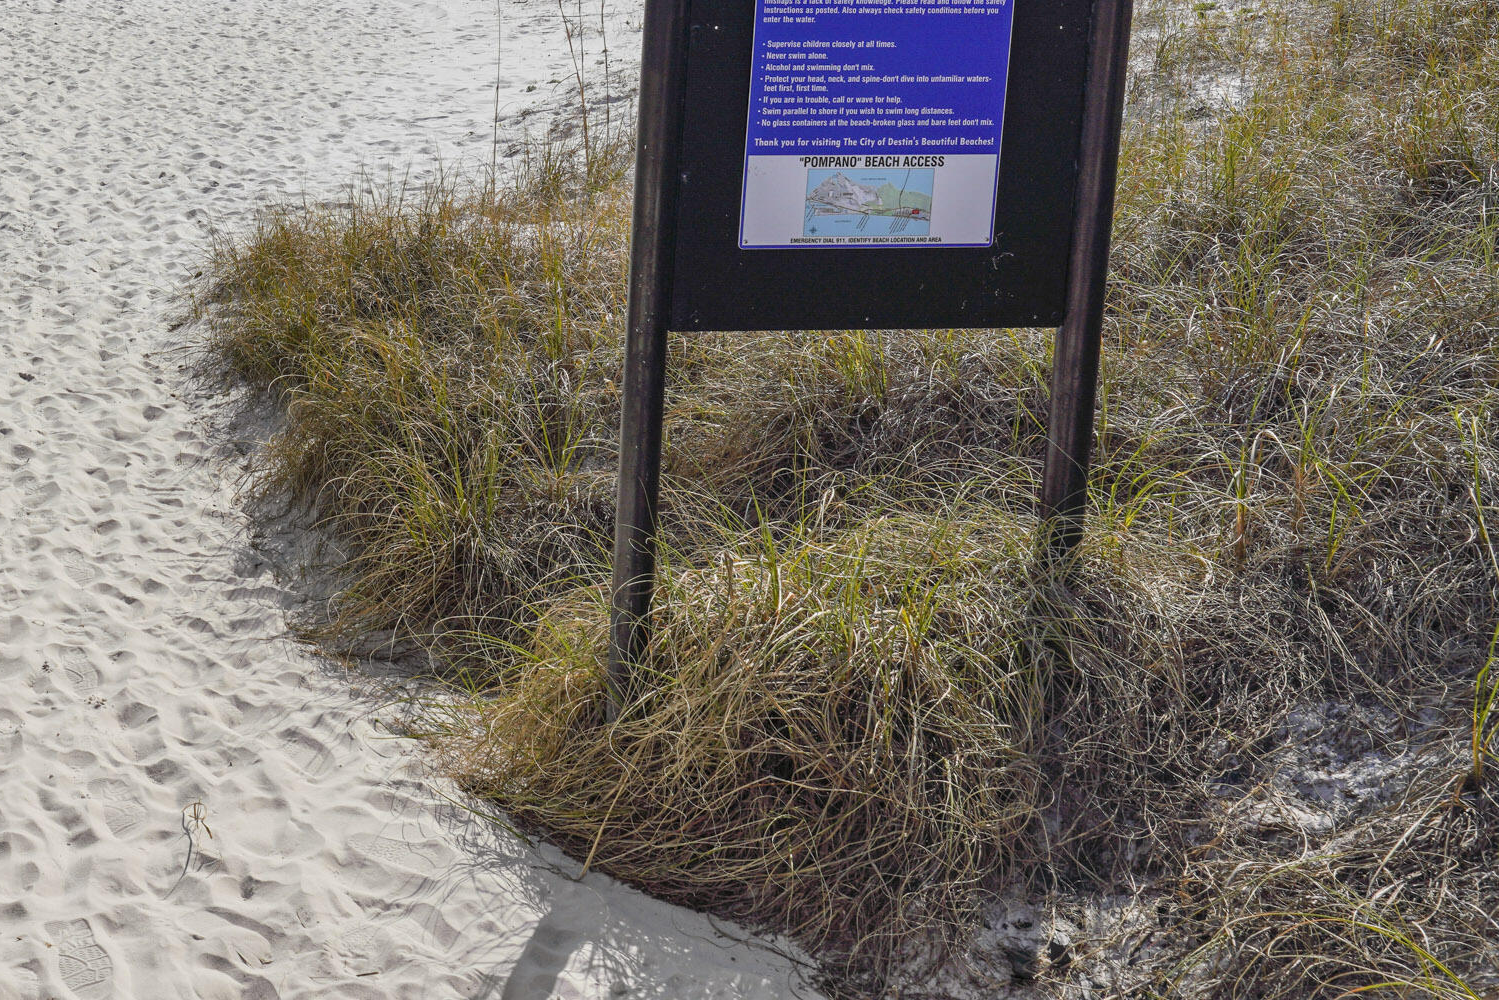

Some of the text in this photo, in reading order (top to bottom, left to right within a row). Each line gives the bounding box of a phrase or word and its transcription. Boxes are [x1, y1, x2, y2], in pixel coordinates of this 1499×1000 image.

[858, 7, 882, 15] always
[905, 7, 926, 15] safety
[767, 40, 801, 49] Supervise
[832, 40, 856, 49] closely
[806, 64, 841, 72] swimming
[861, 75, 899, 84] spine-don't
[782, 108, 809, 116] parallel
[904, 107, 919, 116] long
[772, 119, 791, 128] glass
[897, 119, 915, 127] glass
[754, 136, 994, 148] Thank you for visiting The City of Destin's Beautiful Beaches!
[799, 156, 945, 168] "POMPANO" BEACH ACCESS
